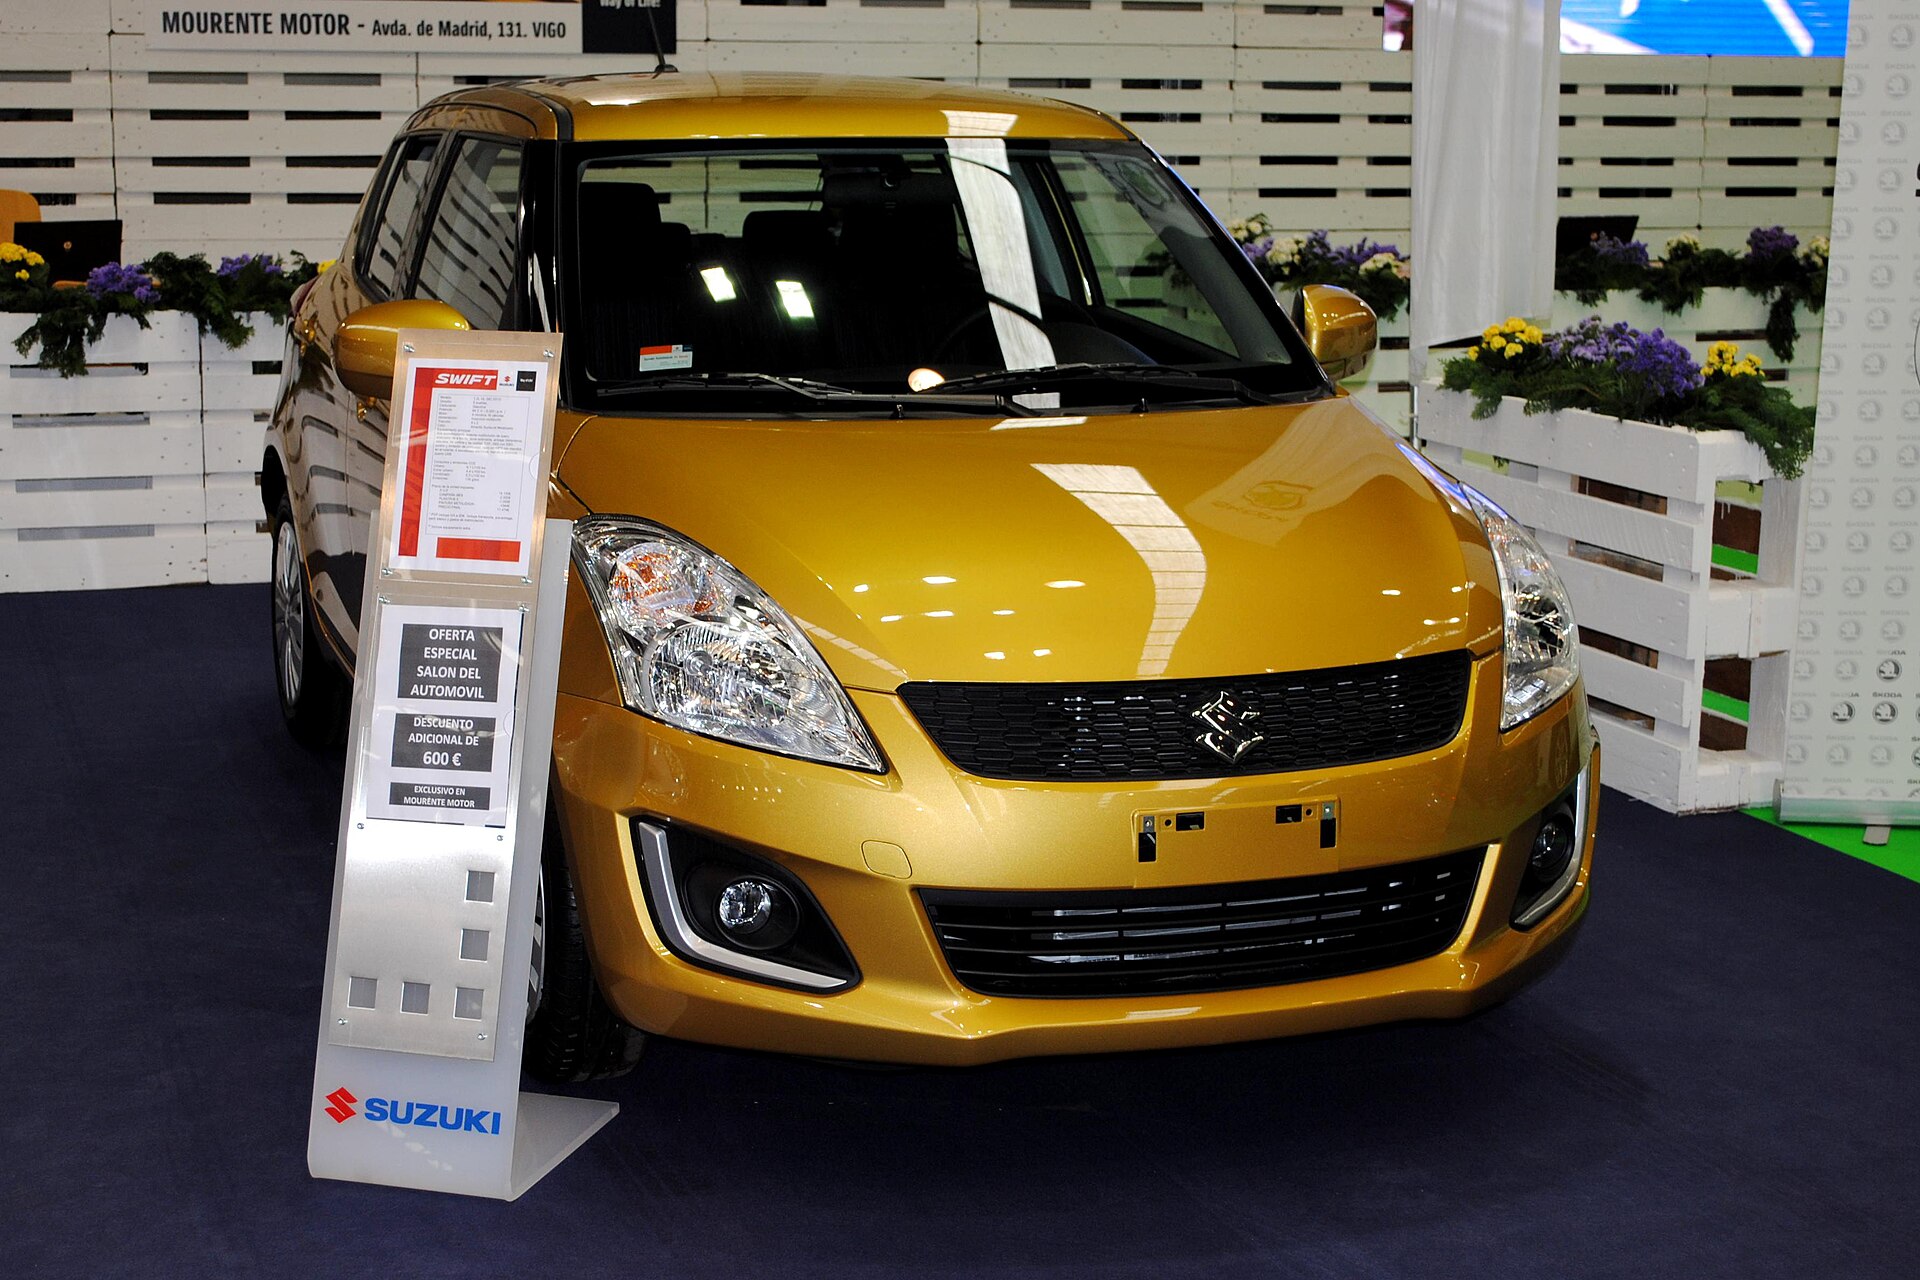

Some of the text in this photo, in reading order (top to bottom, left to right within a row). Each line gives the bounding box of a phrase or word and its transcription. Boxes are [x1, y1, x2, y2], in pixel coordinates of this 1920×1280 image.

[162, 11, 273, 34] MOURENTE
[280, 13, 350, 36] MOTOR
[372, 20, 412, 36] Avda.
[417, 20, 433, 37] de
[438, 20, 492, 40] Madrid,
[498, 22, 527, 38] 131.
[532, 22, 566, 39] VIGO
[435, 373, 497, 386] SWIFT
[429, 628, 475, 641] OFERTA
[423, 647, 477, 661] ESPECIAL
[416, 665, 481, 680] SALON DEL
[410, 683, 485, 699] AUTOMOVIL
[413, 717, 474, 729] DESCUENTO
[408, 732, 479, 746] ADICIONAL DE
[423, 751, 462, 767] 600 €
[414, 785, 466, 796] EXCLUSIVO EN
[403, 796, 475, 808] MOURENTE MOTOR
[364, 1097, 501, 1135] SUZUKI
